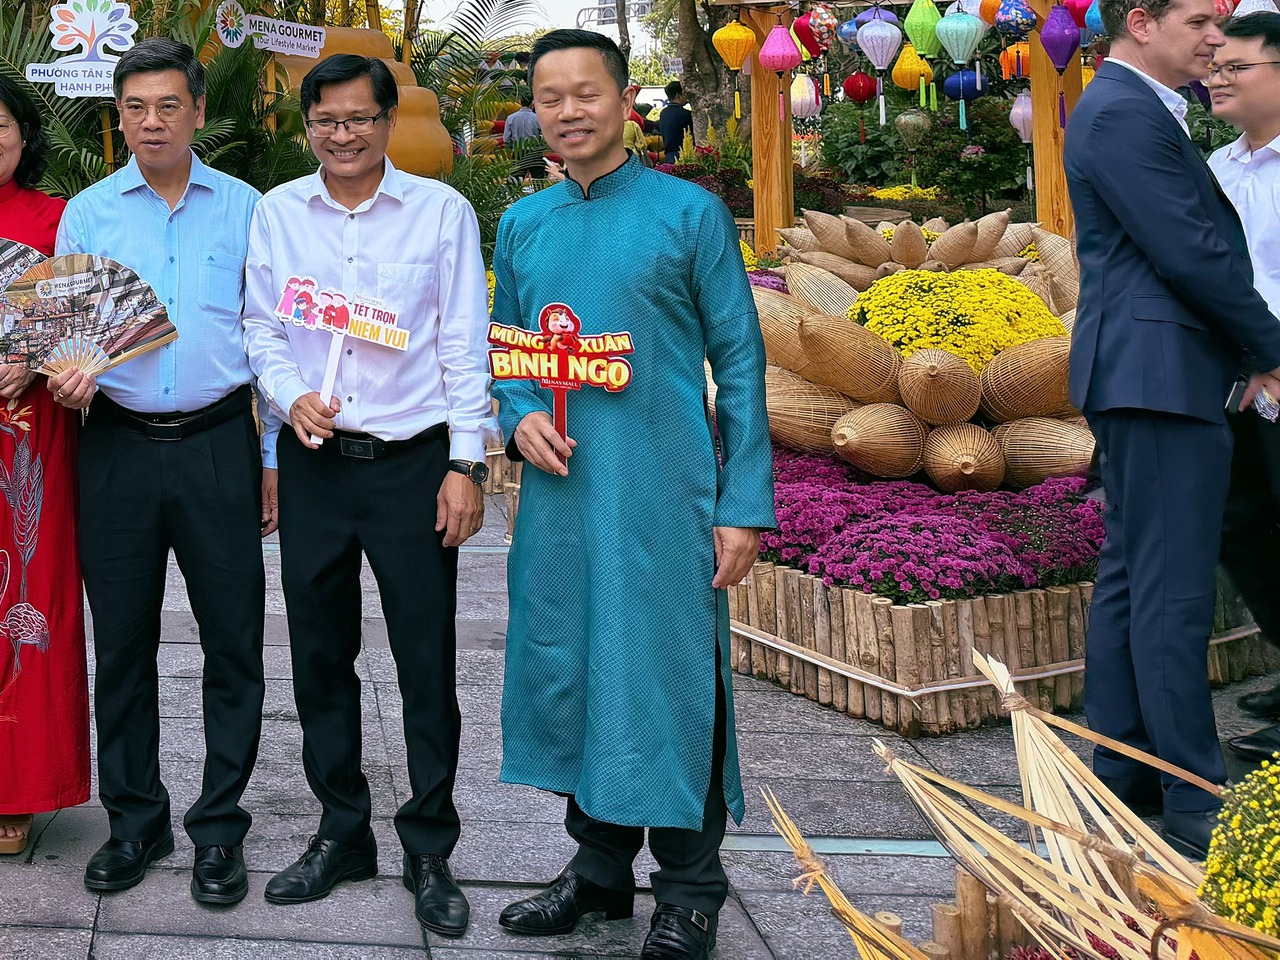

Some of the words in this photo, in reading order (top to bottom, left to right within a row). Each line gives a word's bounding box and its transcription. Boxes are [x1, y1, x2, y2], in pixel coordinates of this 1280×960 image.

[249, 19, 277, 35] MENA
[278, 24, 323, 42] GOURMET
[271, 37, 296, 50] Lifestyle
[296, 42, 317, 53] Market
[31, 67, 79, 78] PHƯỜNG
[81, 67, 103, 79] TÂN
[60, 82, 92, 94] HẠNH
[371, 308, 396, 325] TRỌN
[385, 327, 407, 349] VUI
[489, 324, 545, 350] MỪNG
[578, 333, 632, 353] XUÂN
[567, 355, 630, 389] NGỌ
